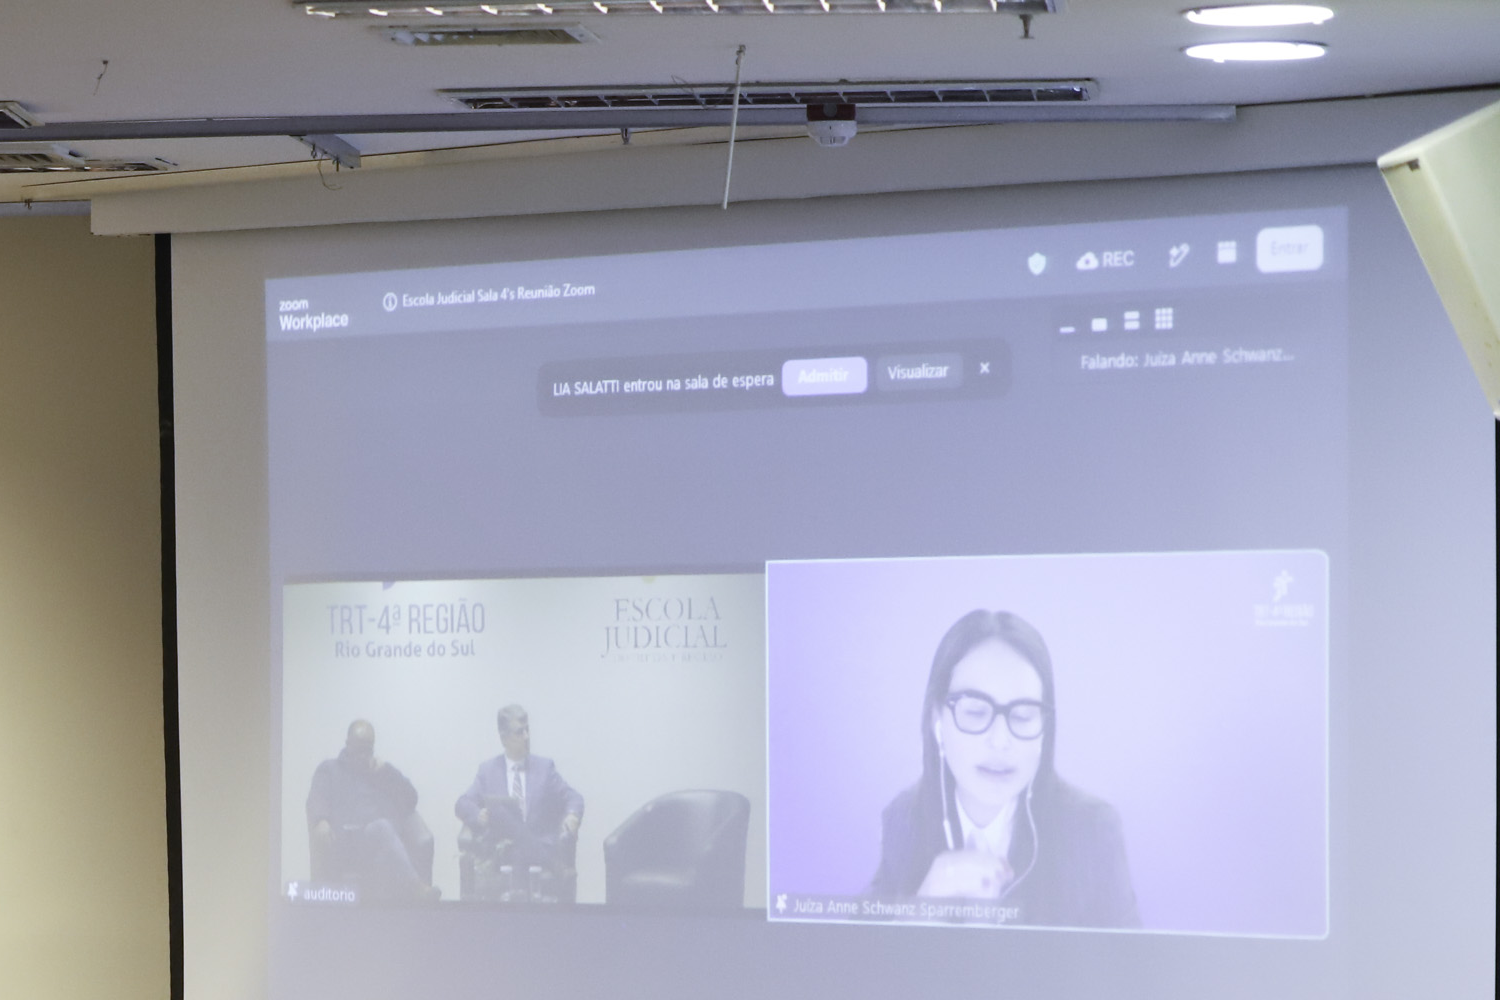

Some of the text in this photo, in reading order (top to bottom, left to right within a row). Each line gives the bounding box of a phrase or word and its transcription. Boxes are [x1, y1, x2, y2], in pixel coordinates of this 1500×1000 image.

[1102, 250, 1135, 268] REC
[402, 282, 596, 307] Escola Judicial Sala 4's Reunião Zoom
[279, 299, 309, 311] zoom
[279, 312, 349, 332] Workplace
[1080, 353, 1139, 370] Falando:
[1181, 350, 1218, 366] Anne
[797, 367, 850, 385] Admitir
[887, 362, 950, 380] Visualizar
[553, 373, 775, 397] LIA SALATTI entrou na sala de espera
[325, 597, 486, 637] TRT-4ª REGIÃO
[613, 596, 723, 622] ESCOLA
[335, 639, 476, 659] Rio Grande do Sul
[600, 625, 728, 659] JUDICIAL
[827, 899, 858, 914] Anne
[862, 900, 916, 916] Schwanz
